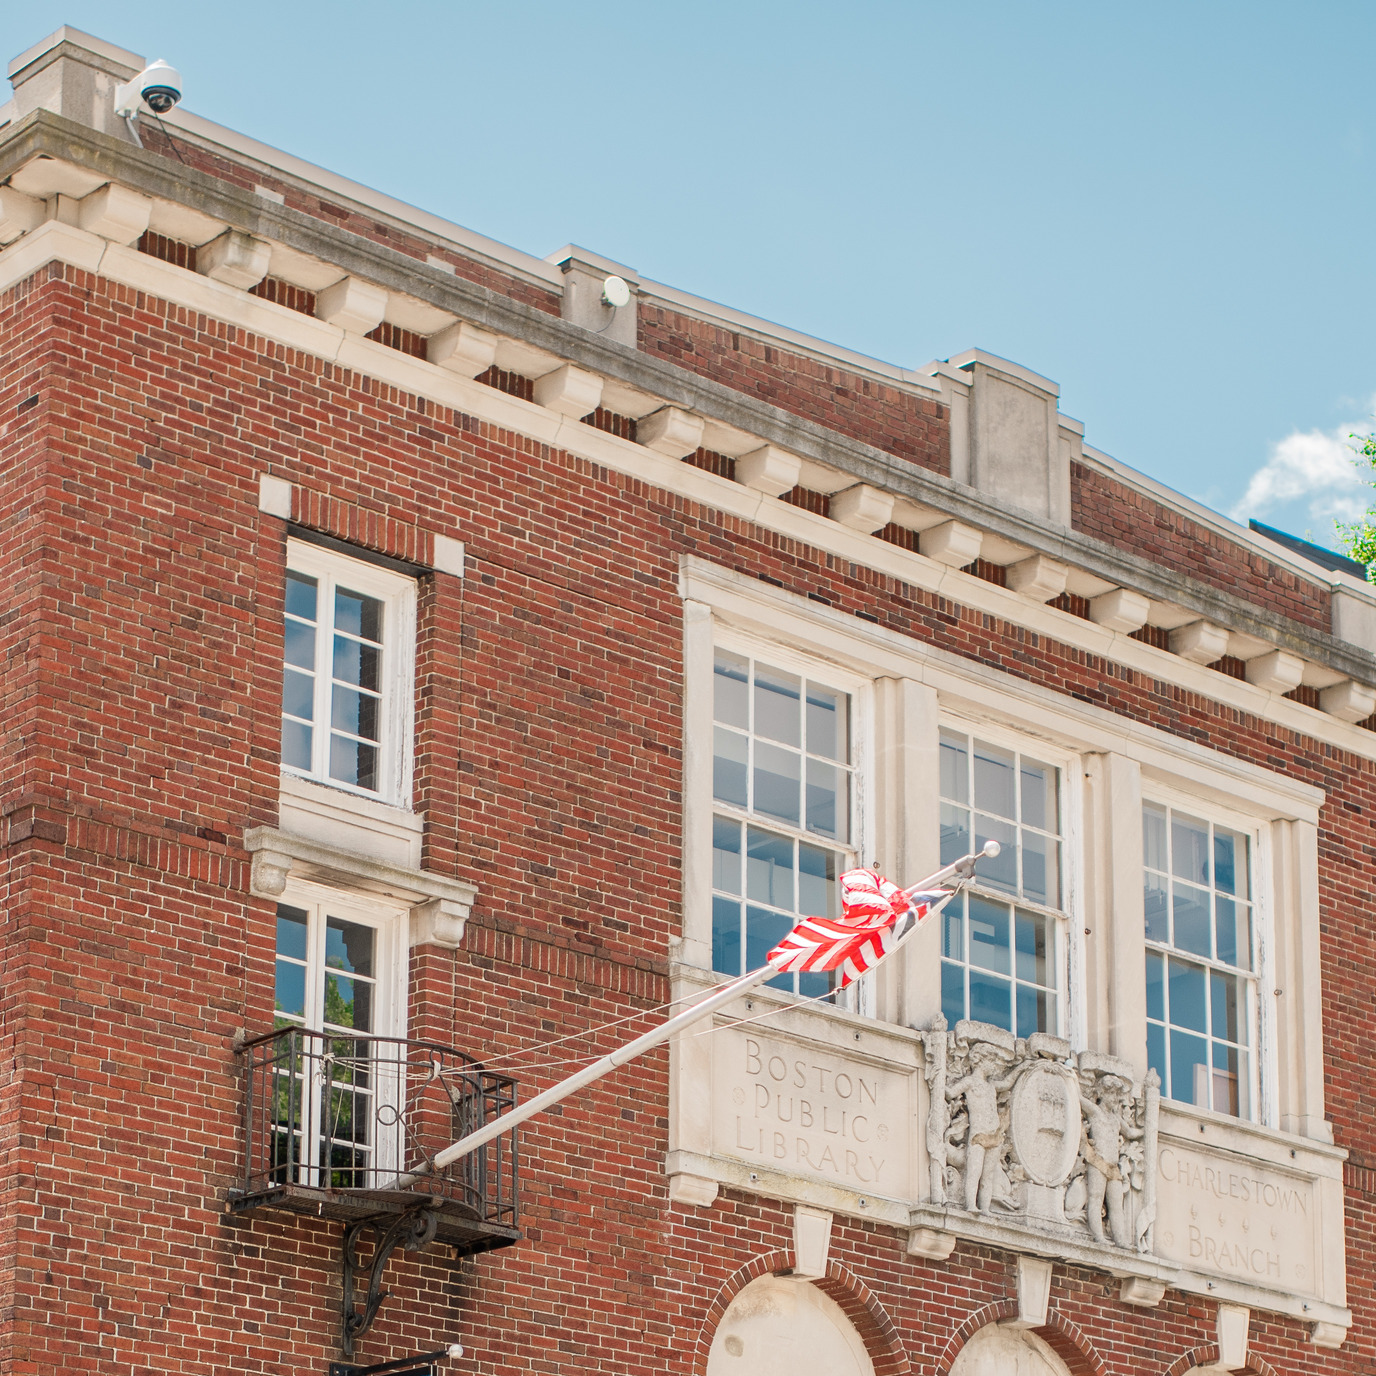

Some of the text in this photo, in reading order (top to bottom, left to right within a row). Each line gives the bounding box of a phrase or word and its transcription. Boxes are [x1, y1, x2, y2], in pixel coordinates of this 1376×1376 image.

[745, 1038, 877, 1106] BOSTON
[754, 1082, 870, 1143] PUBLIC
[735, 1114, 885, 1183] LIBRARY
[1158, 1148, 1308, 1217] CHARLESTOWN
[1188, 1223, 1281, 1279] BRANCH
